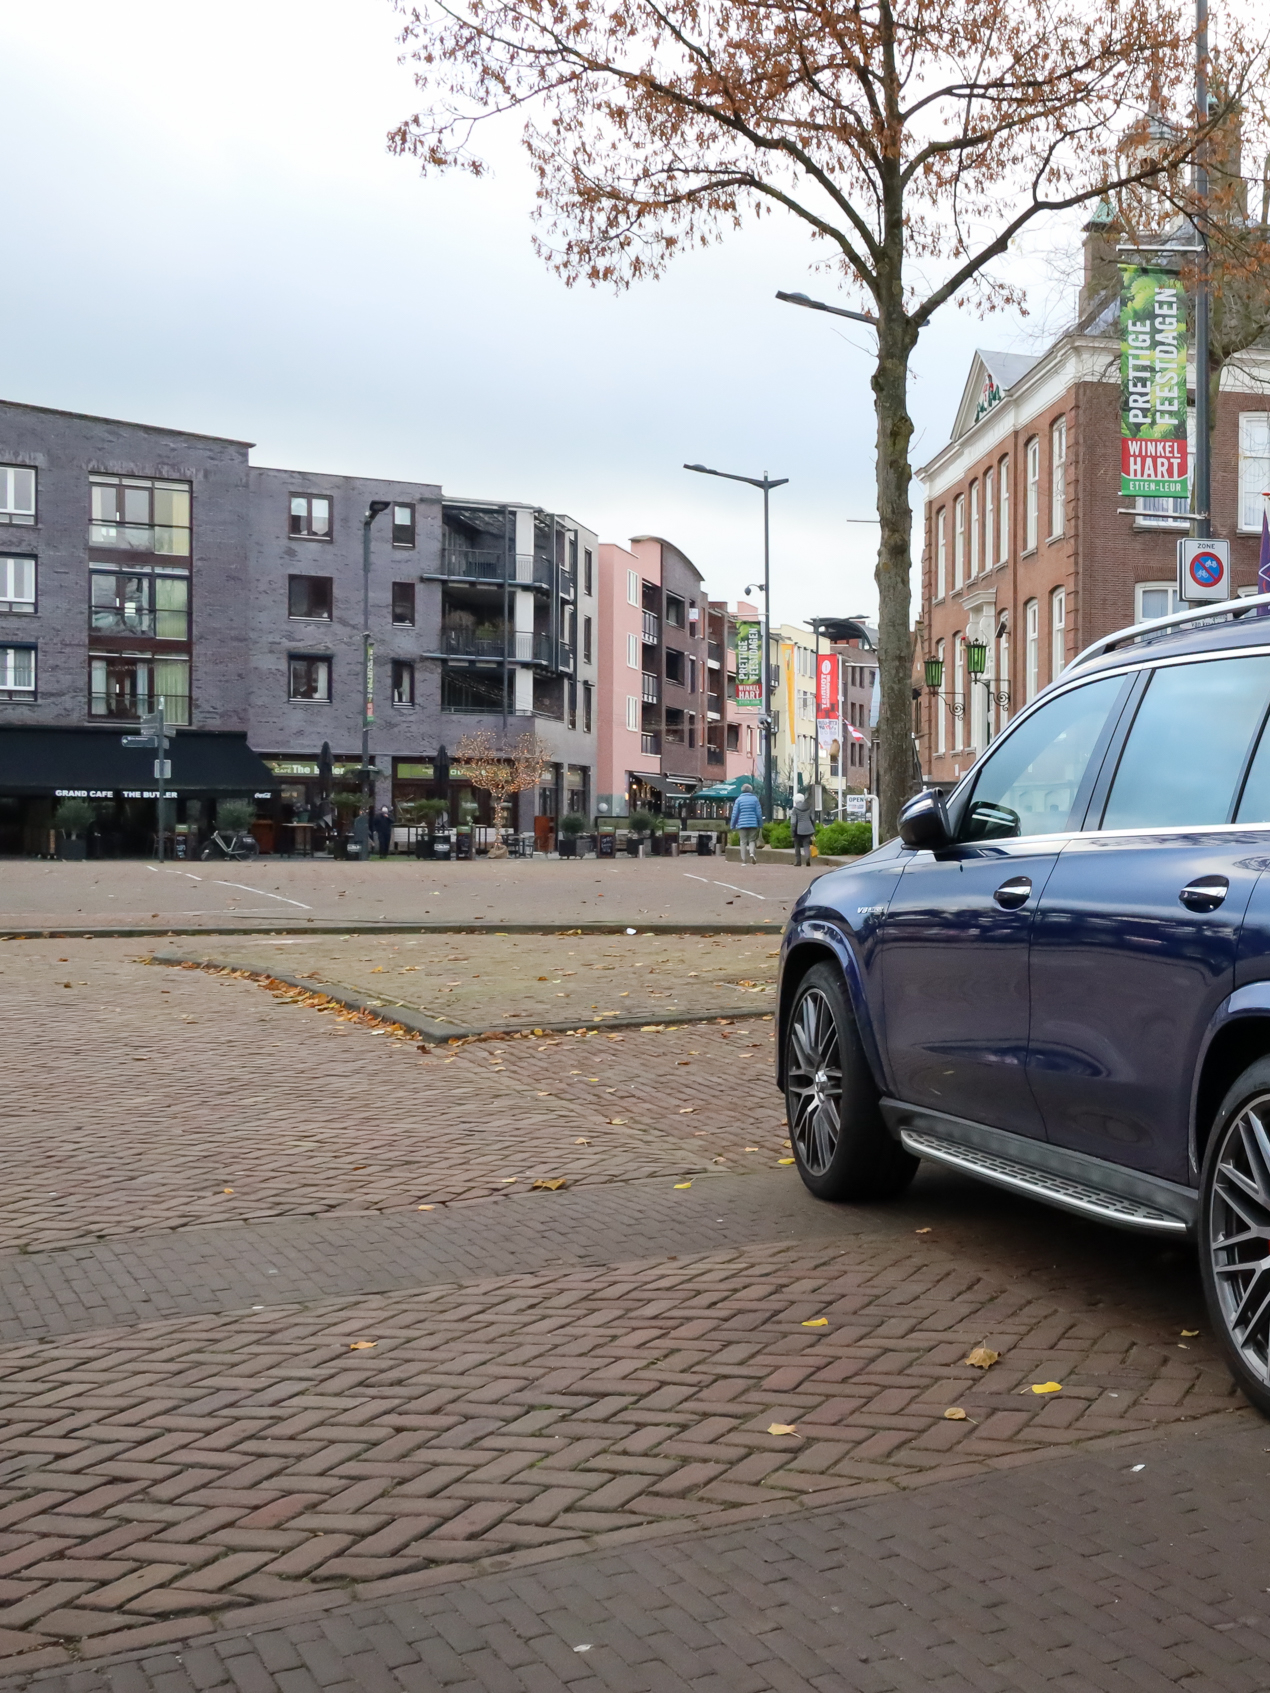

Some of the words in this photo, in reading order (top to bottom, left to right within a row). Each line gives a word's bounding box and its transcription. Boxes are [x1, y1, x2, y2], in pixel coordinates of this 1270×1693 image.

[1154, 287, 1179, 425] FEESTDAGEN
[1128, 319, 1152, 424] PRETTIGE
[1128, 440, 1182, 457] WINKEL
[1129, 457, 1182, 479] HART
[1129, 481, 1182, 492] ETTEN-LEUR
[738, 640, 748, 680] PRETTIGE
[748, 628, 759, 680] FEESTDAGEN
[739, 691, 760, 700] HART
[293, 764, 311, 774] The
[314, 765, 345, 775] bler
